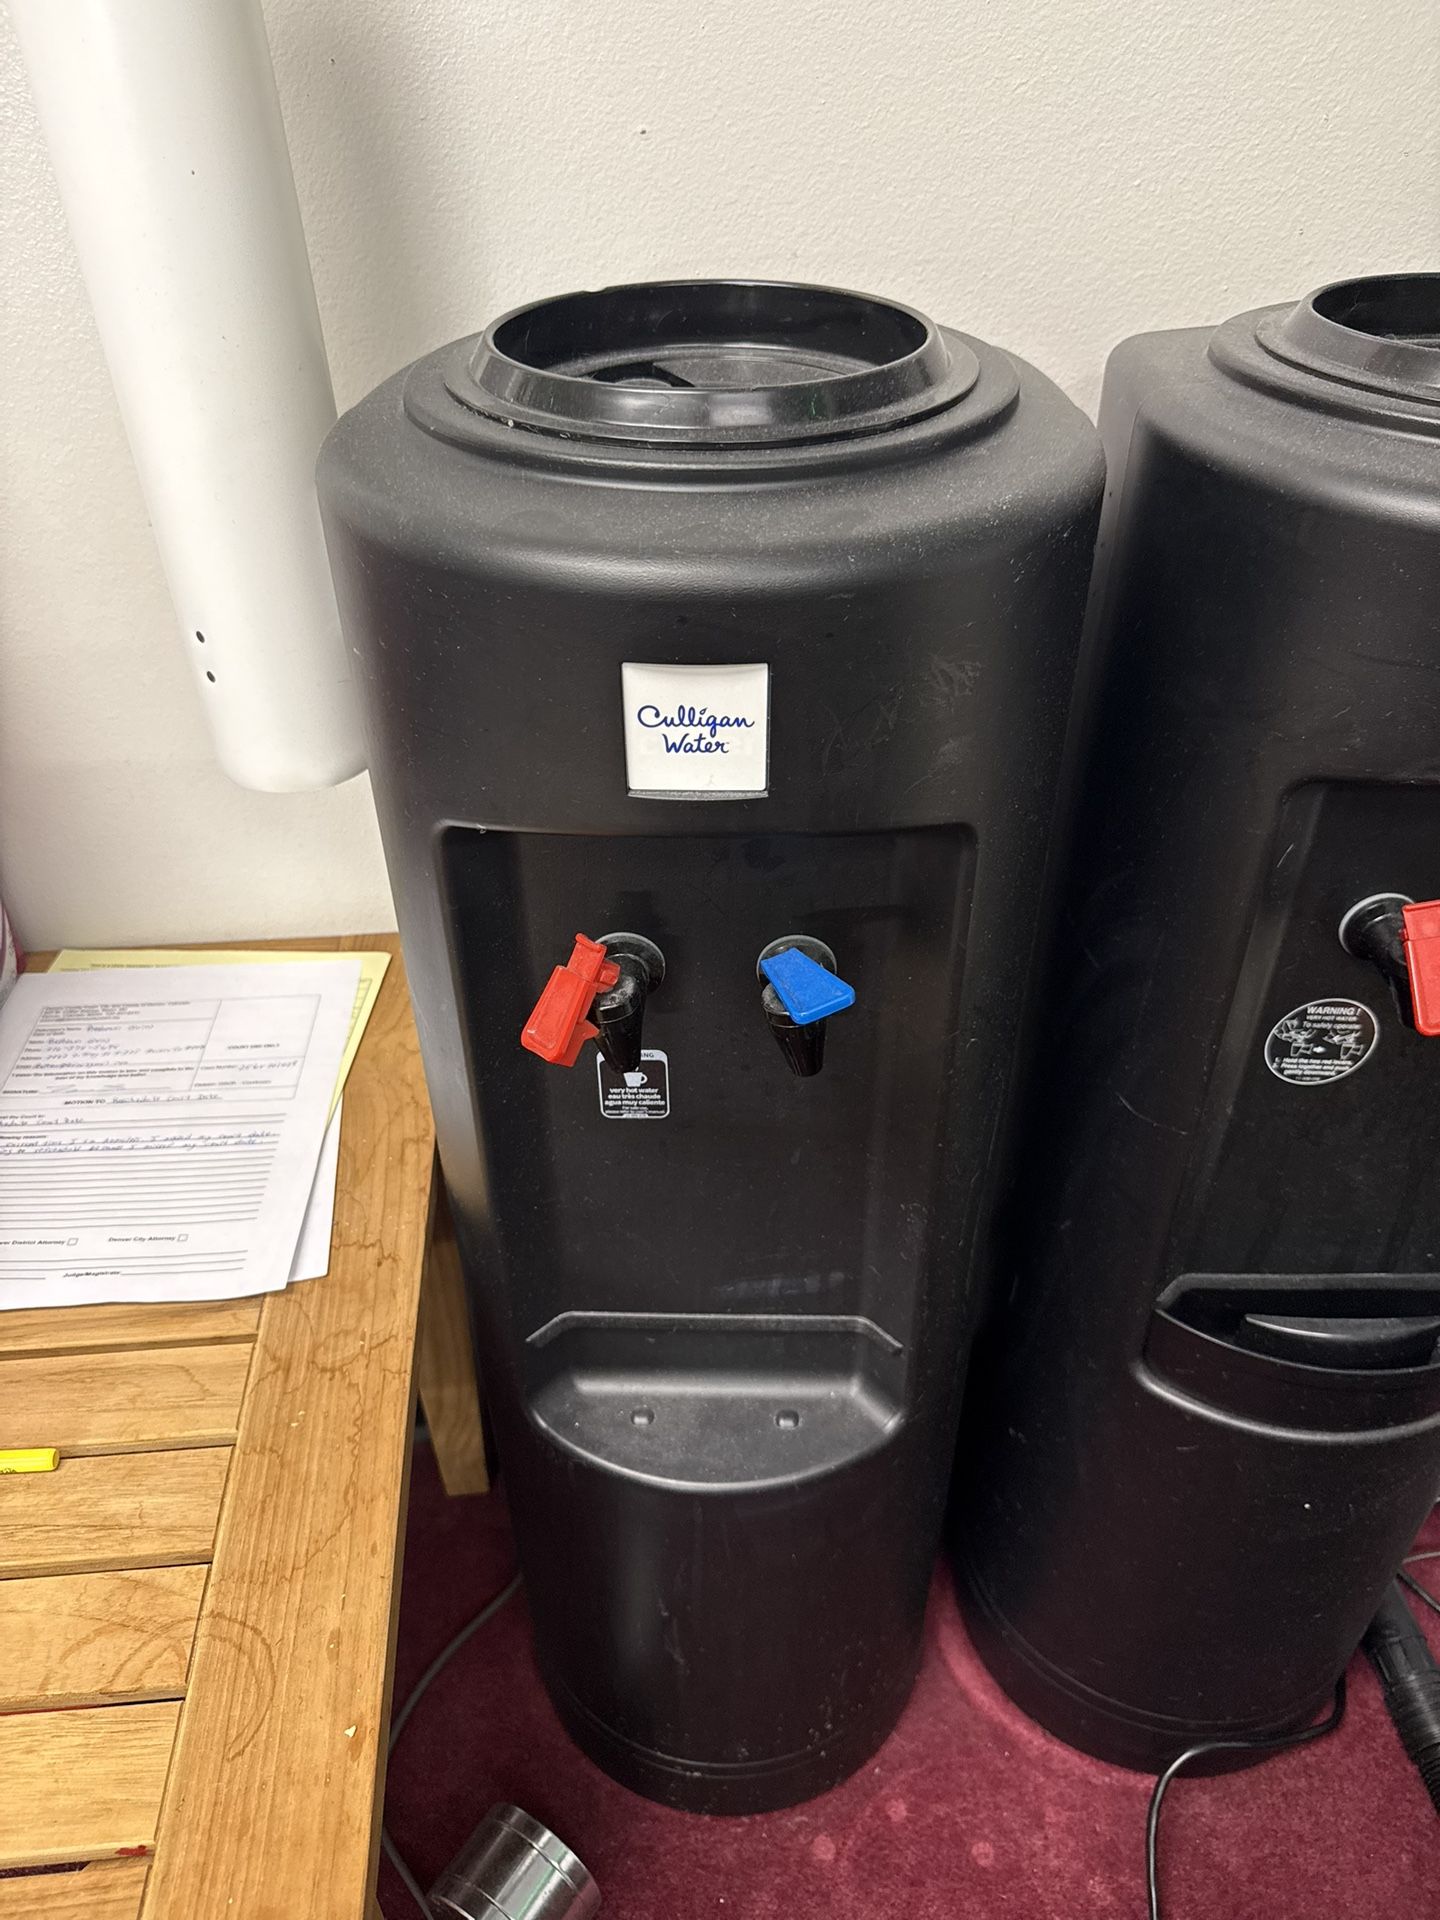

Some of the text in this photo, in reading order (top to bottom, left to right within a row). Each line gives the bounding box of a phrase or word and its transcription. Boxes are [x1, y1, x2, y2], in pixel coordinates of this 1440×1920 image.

[637, 704, 755, 738] Culligan
[662, 733, 730, 754] Water
[1307, 1006, 1361, 1016] WARNING !
[609, 1087, 626, 1095] very
[626, 1086, 638, 1094] hot
[621, 1092, 636, 1100] très
[133, 1235, 147, 1243] City
[147, 1235, 176, 1243] Attorney
